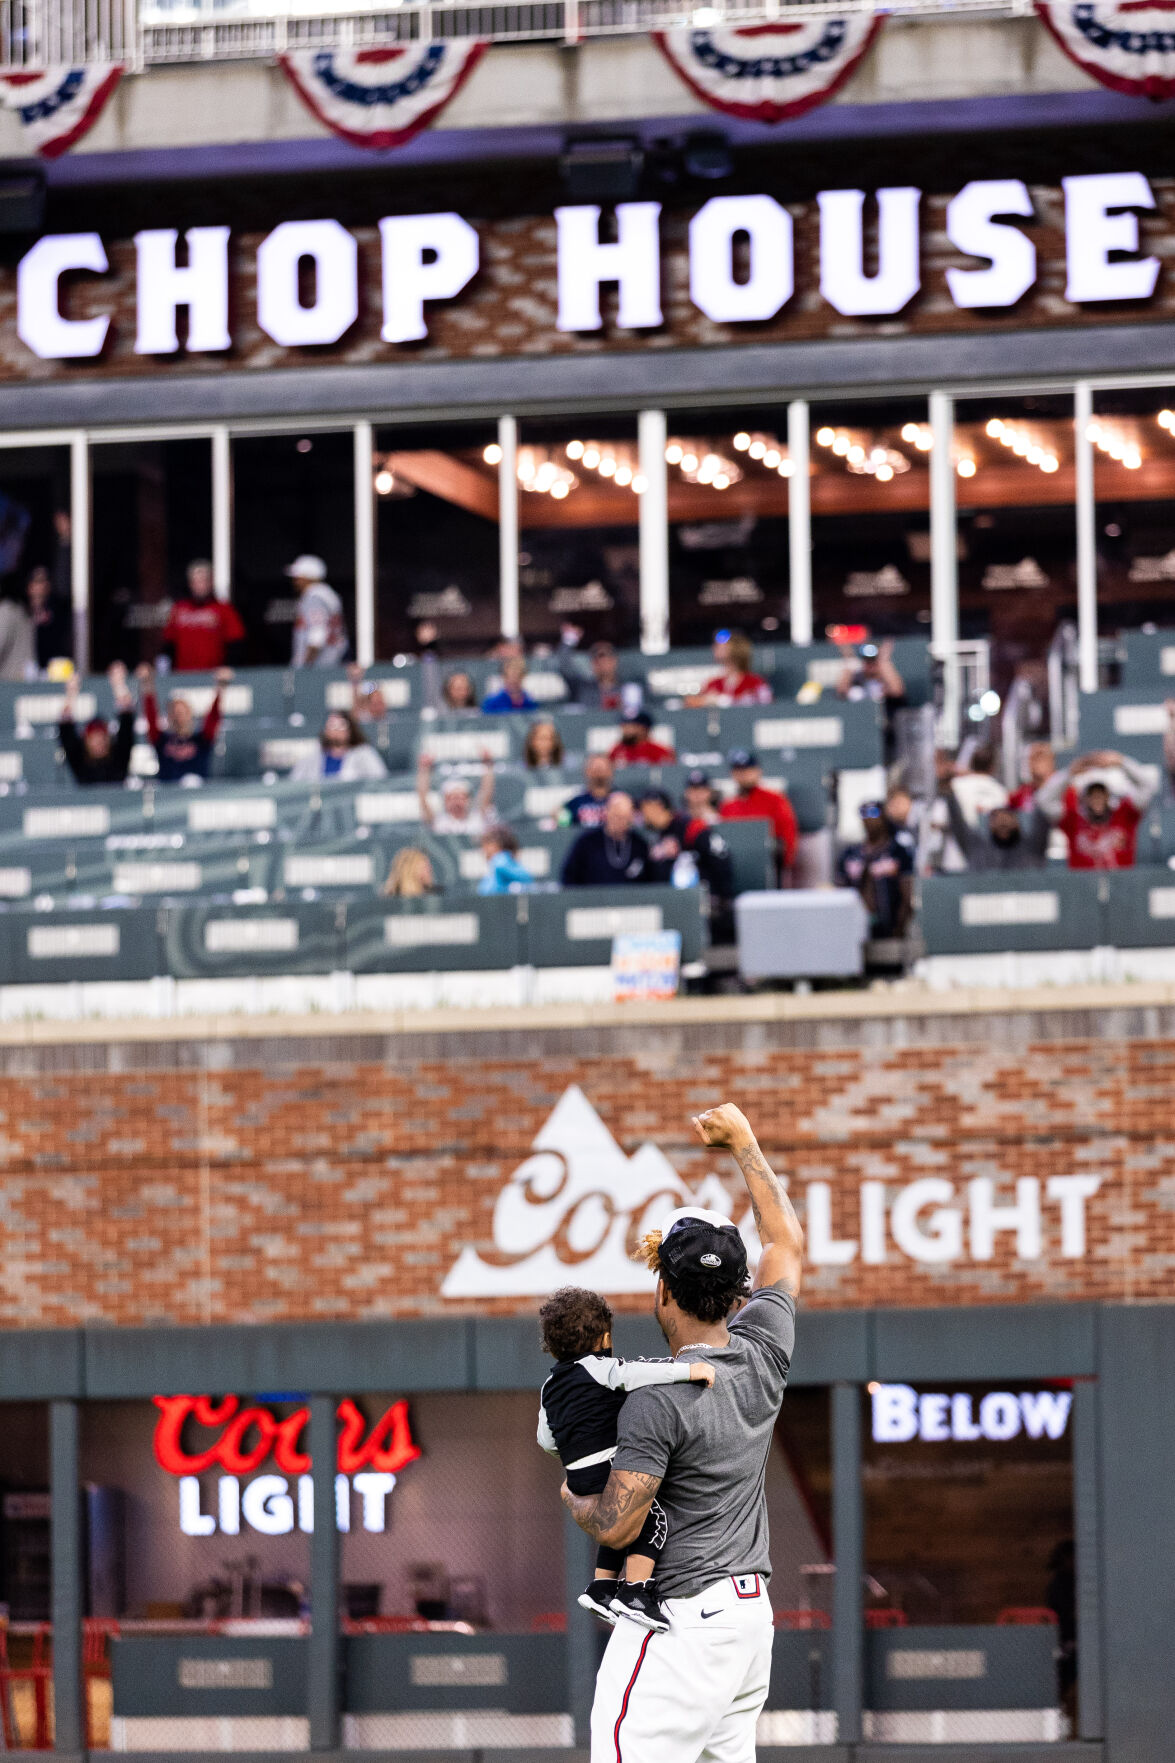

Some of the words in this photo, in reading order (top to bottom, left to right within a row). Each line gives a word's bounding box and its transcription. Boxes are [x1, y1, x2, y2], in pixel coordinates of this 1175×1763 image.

[16, 211, 480, 360] CHOP
[553, 172, 1162, 332] HOUSE
[808, 1174, 1101, 1265] LIGHT
[870, 1383, 1072, 1443] BELOW
